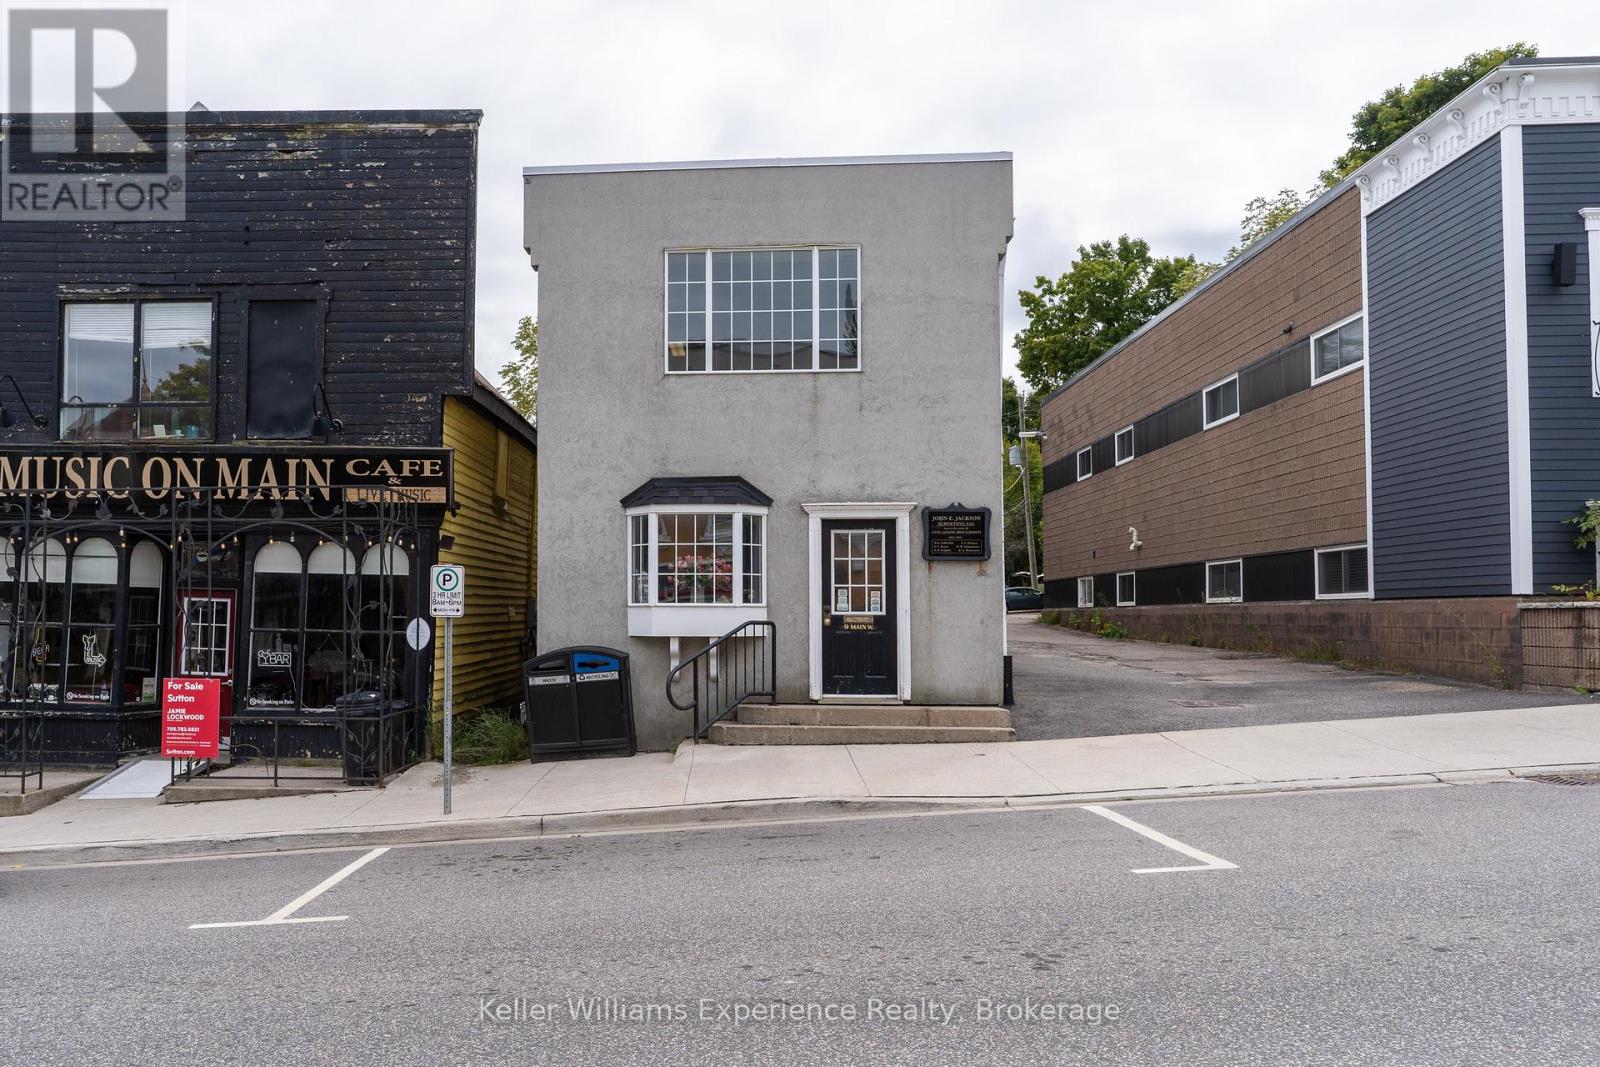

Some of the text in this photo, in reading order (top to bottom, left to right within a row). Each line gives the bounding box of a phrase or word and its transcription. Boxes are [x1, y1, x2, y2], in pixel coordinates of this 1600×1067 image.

[345, 458, 444, 477] CAFE
[0, 456, 335, 501] MUSIC ON MAIN
[387, 476, 402, 485] &
[442, 573, 453, 586] P
[432, 591, 461, 599] 3 HR LIMIT
[270, 654, 290, 664] BAR
[167, 681, 204, 690] For Sale
[167, 694, 195, 703] Sutton
